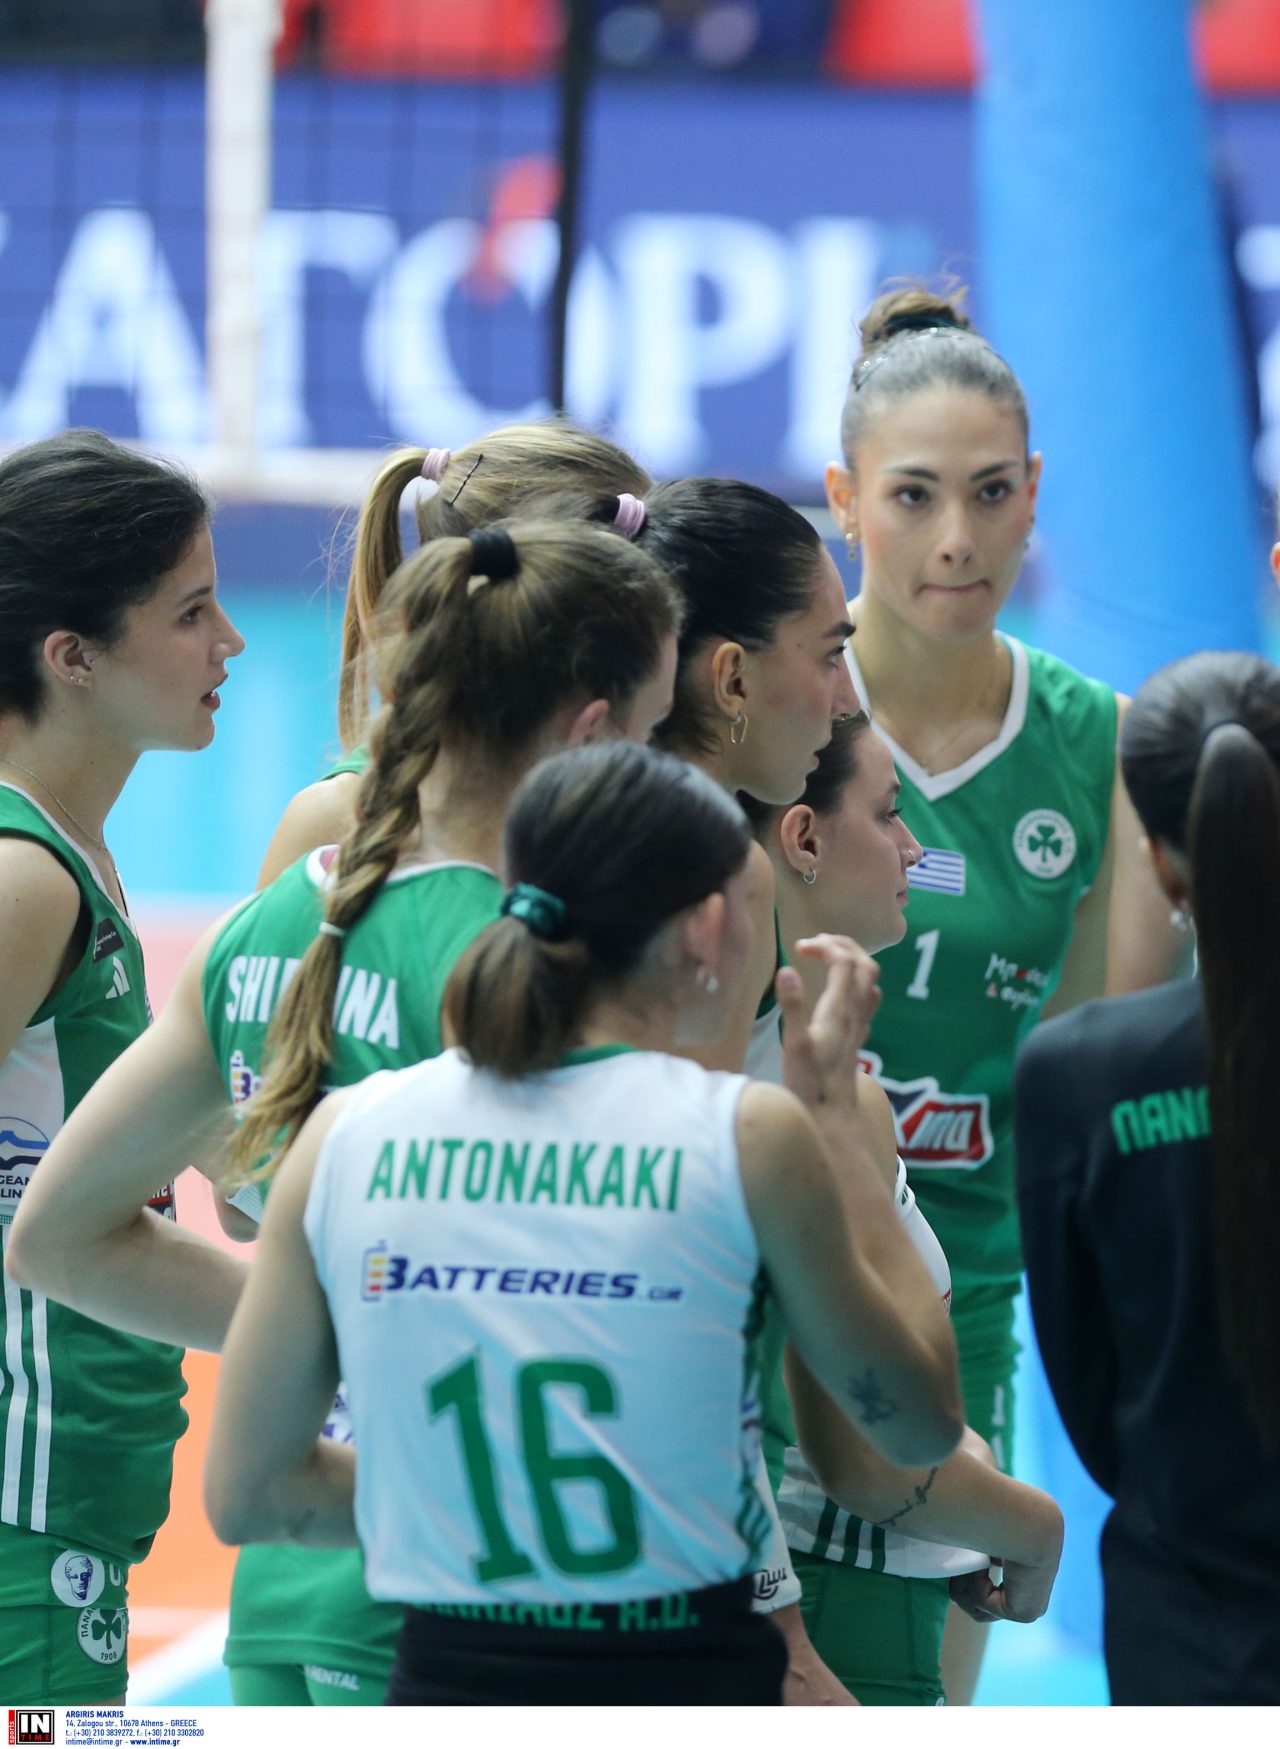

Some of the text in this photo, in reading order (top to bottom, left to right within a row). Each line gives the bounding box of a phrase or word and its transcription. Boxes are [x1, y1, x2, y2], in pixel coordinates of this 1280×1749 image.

[0, 205, 882, 482] ΑΓΟΡΙ
[906, 928, 940, 999] 1
[366, 1139, 683, 1212] ANTONAKAKI
[425, 1346, 643, 1585] 16
